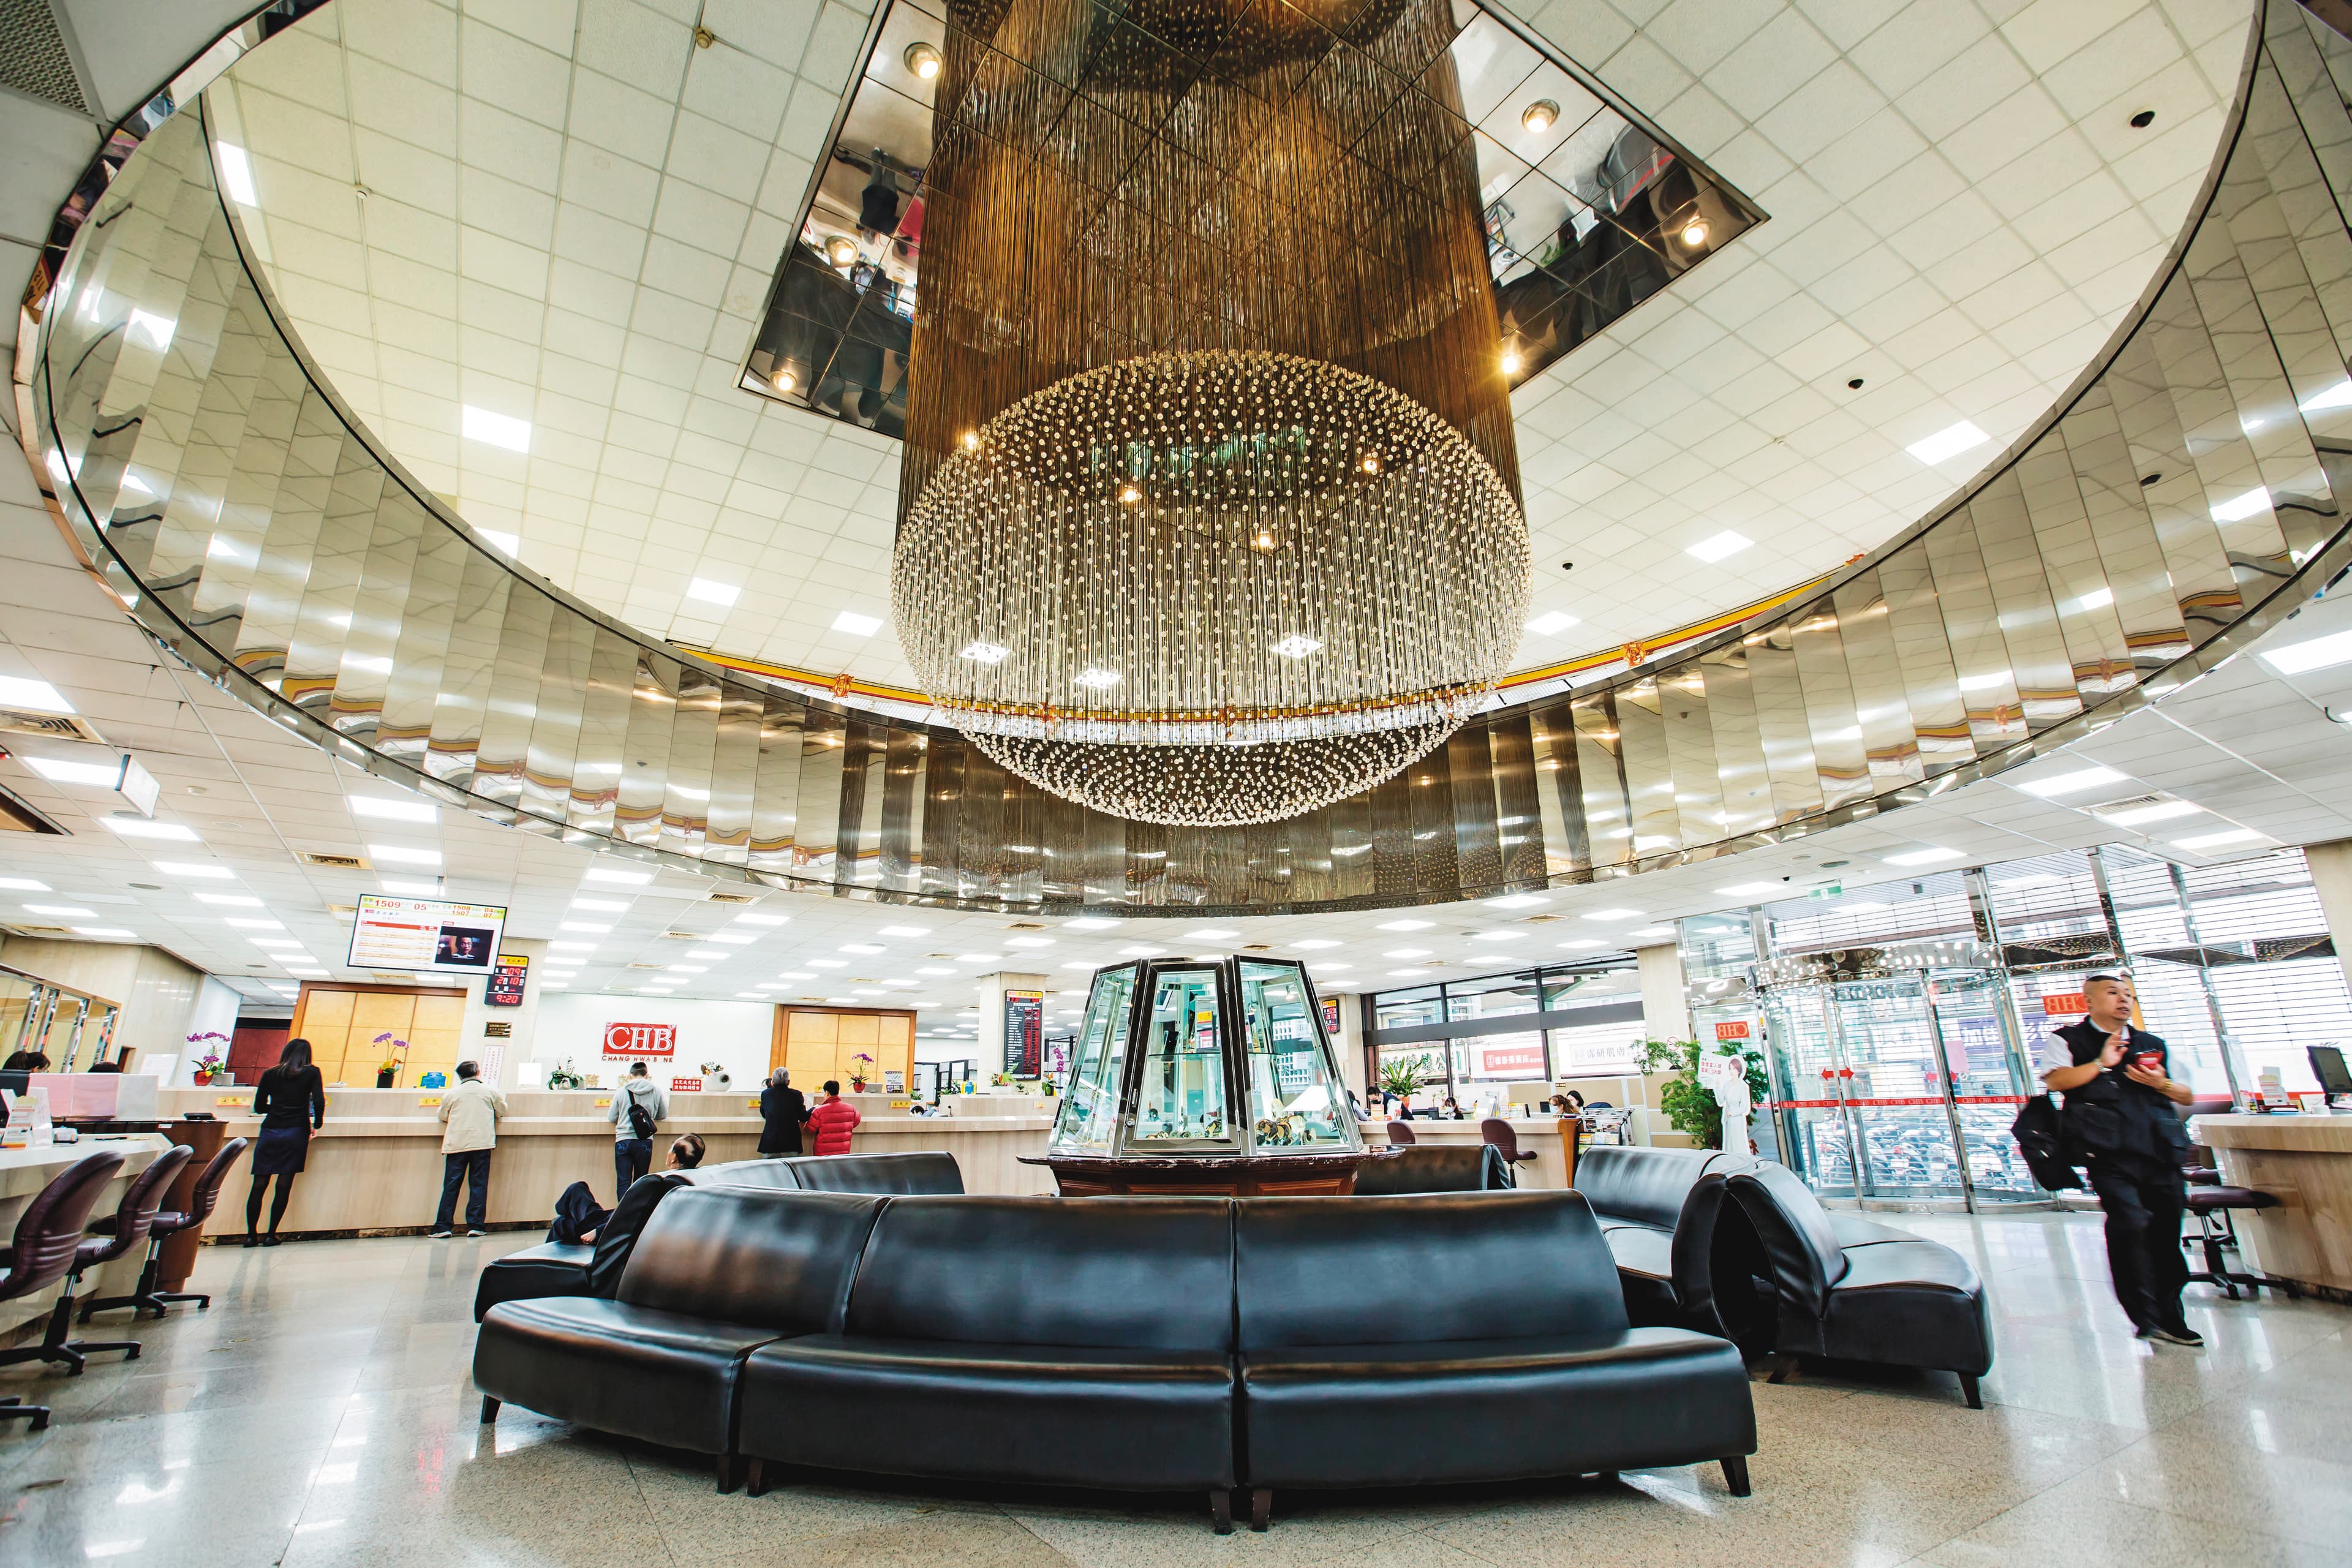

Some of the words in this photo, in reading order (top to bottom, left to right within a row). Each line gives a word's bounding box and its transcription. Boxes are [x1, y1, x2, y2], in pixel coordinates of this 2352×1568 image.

[375, 900, 401, 908] 1509
[496, 995, 519, 1003] 9:20
[607, 1026, 673, 1051] CHB
